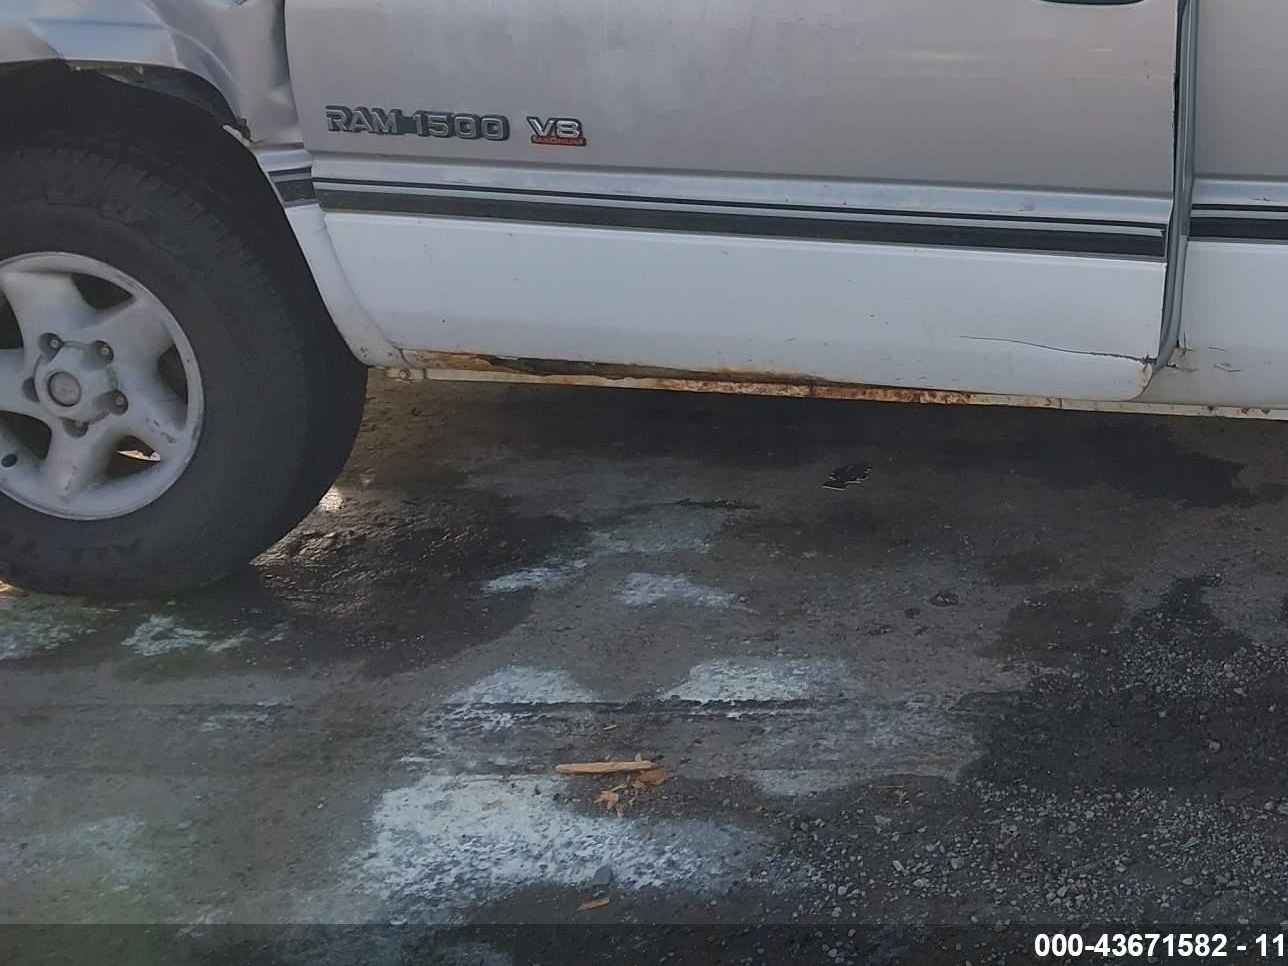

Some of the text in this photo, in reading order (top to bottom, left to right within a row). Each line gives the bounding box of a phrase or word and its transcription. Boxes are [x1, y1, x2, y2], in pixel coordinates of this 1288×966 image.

[326, 106, 582, 141] RAM 1500 V8
